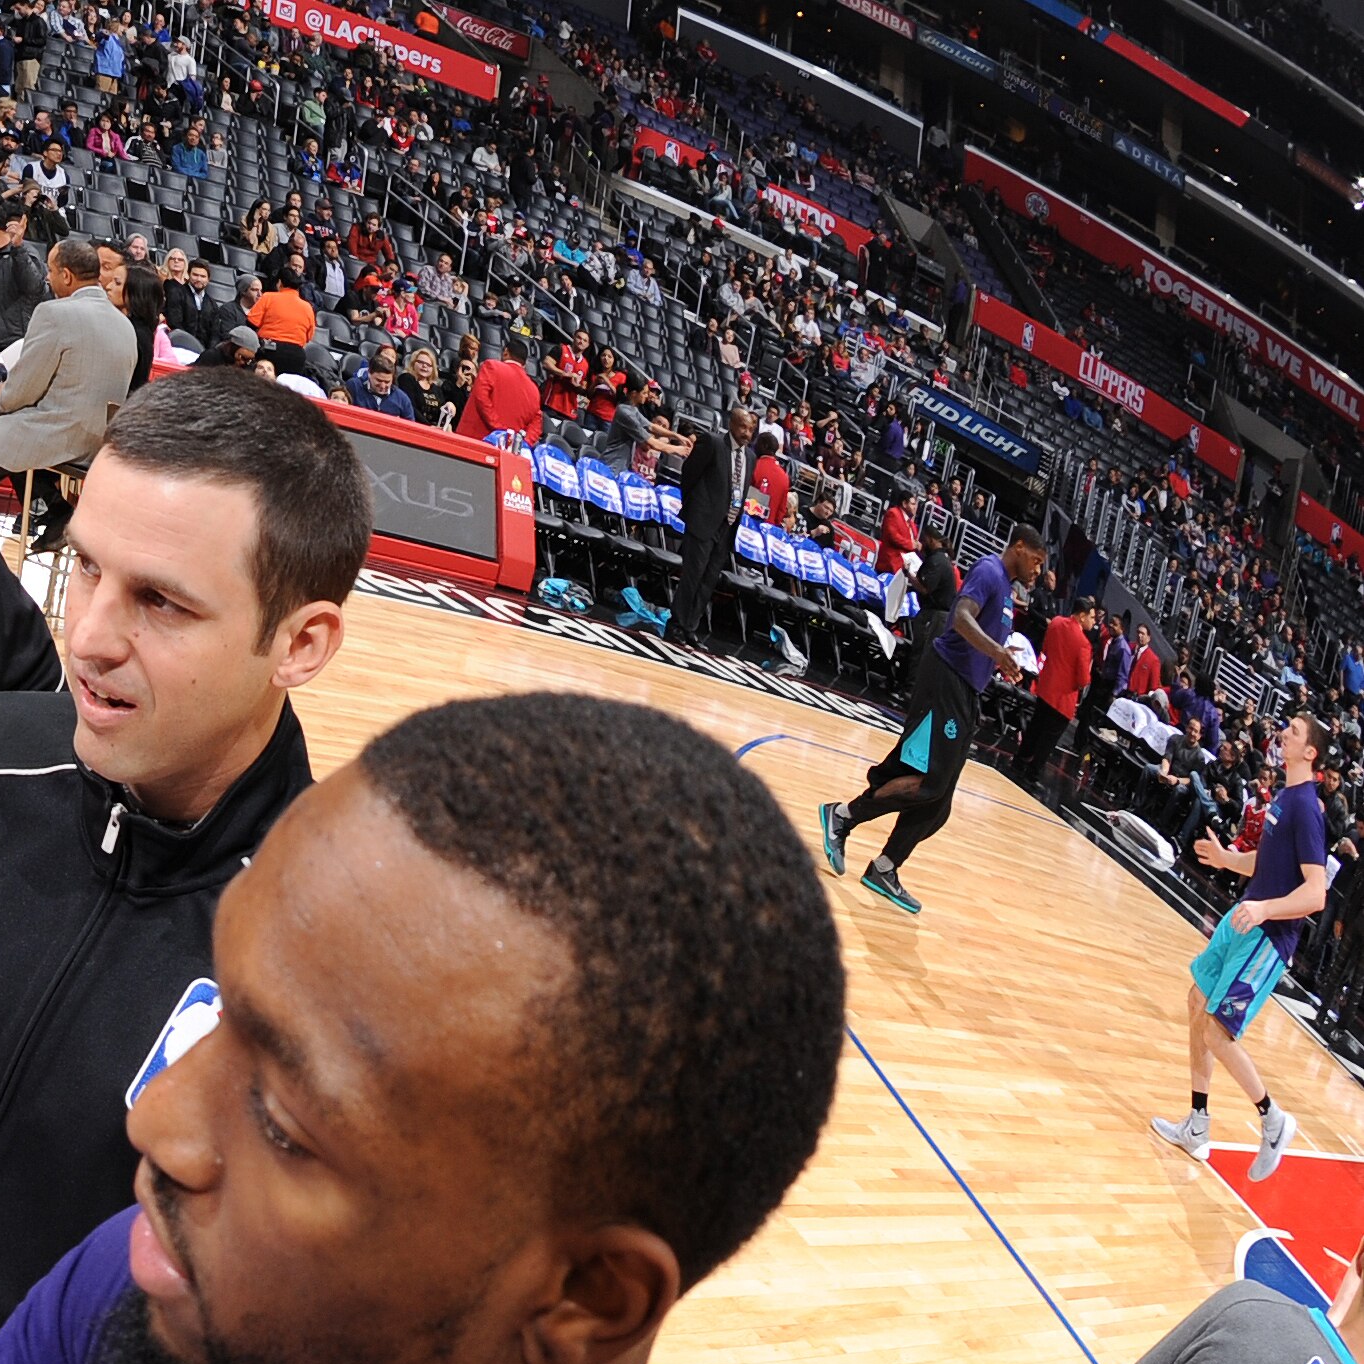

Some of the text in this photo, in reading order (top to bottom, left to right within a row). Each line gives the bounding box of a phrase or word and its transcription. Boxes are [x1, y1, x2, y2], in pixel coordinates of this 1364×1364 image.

[457, 16, 517, 51] Coca-Cola
[950, 47, 994, 75] LIGHT
[1132, 148, 1182, 184] DELTA
[1142, 259, 1360, 421] TOGETHER WE WILL
[1079, 351, 1145, 414] CLIPPERS
[908, 386, 1028, 458] BUD LIGHT
